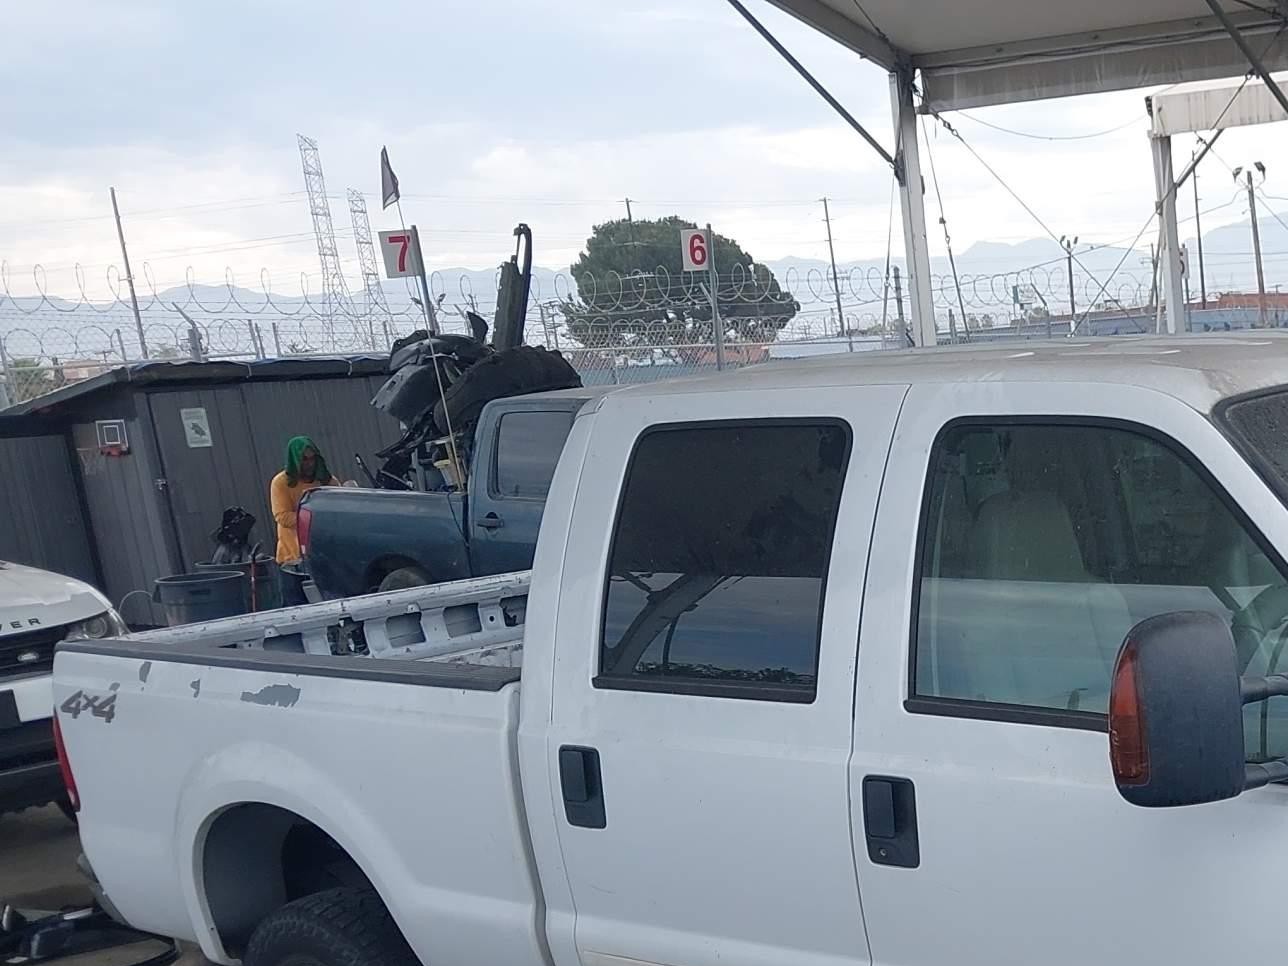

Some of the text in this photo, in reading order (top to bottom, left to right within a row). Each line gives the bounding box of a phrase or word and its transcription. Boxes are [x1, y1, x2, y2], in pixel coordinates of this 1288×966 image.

[388, 235, 410, 272] 7
[689, 233, 707, 266] 6
[0, 618, 41, 631] ER
